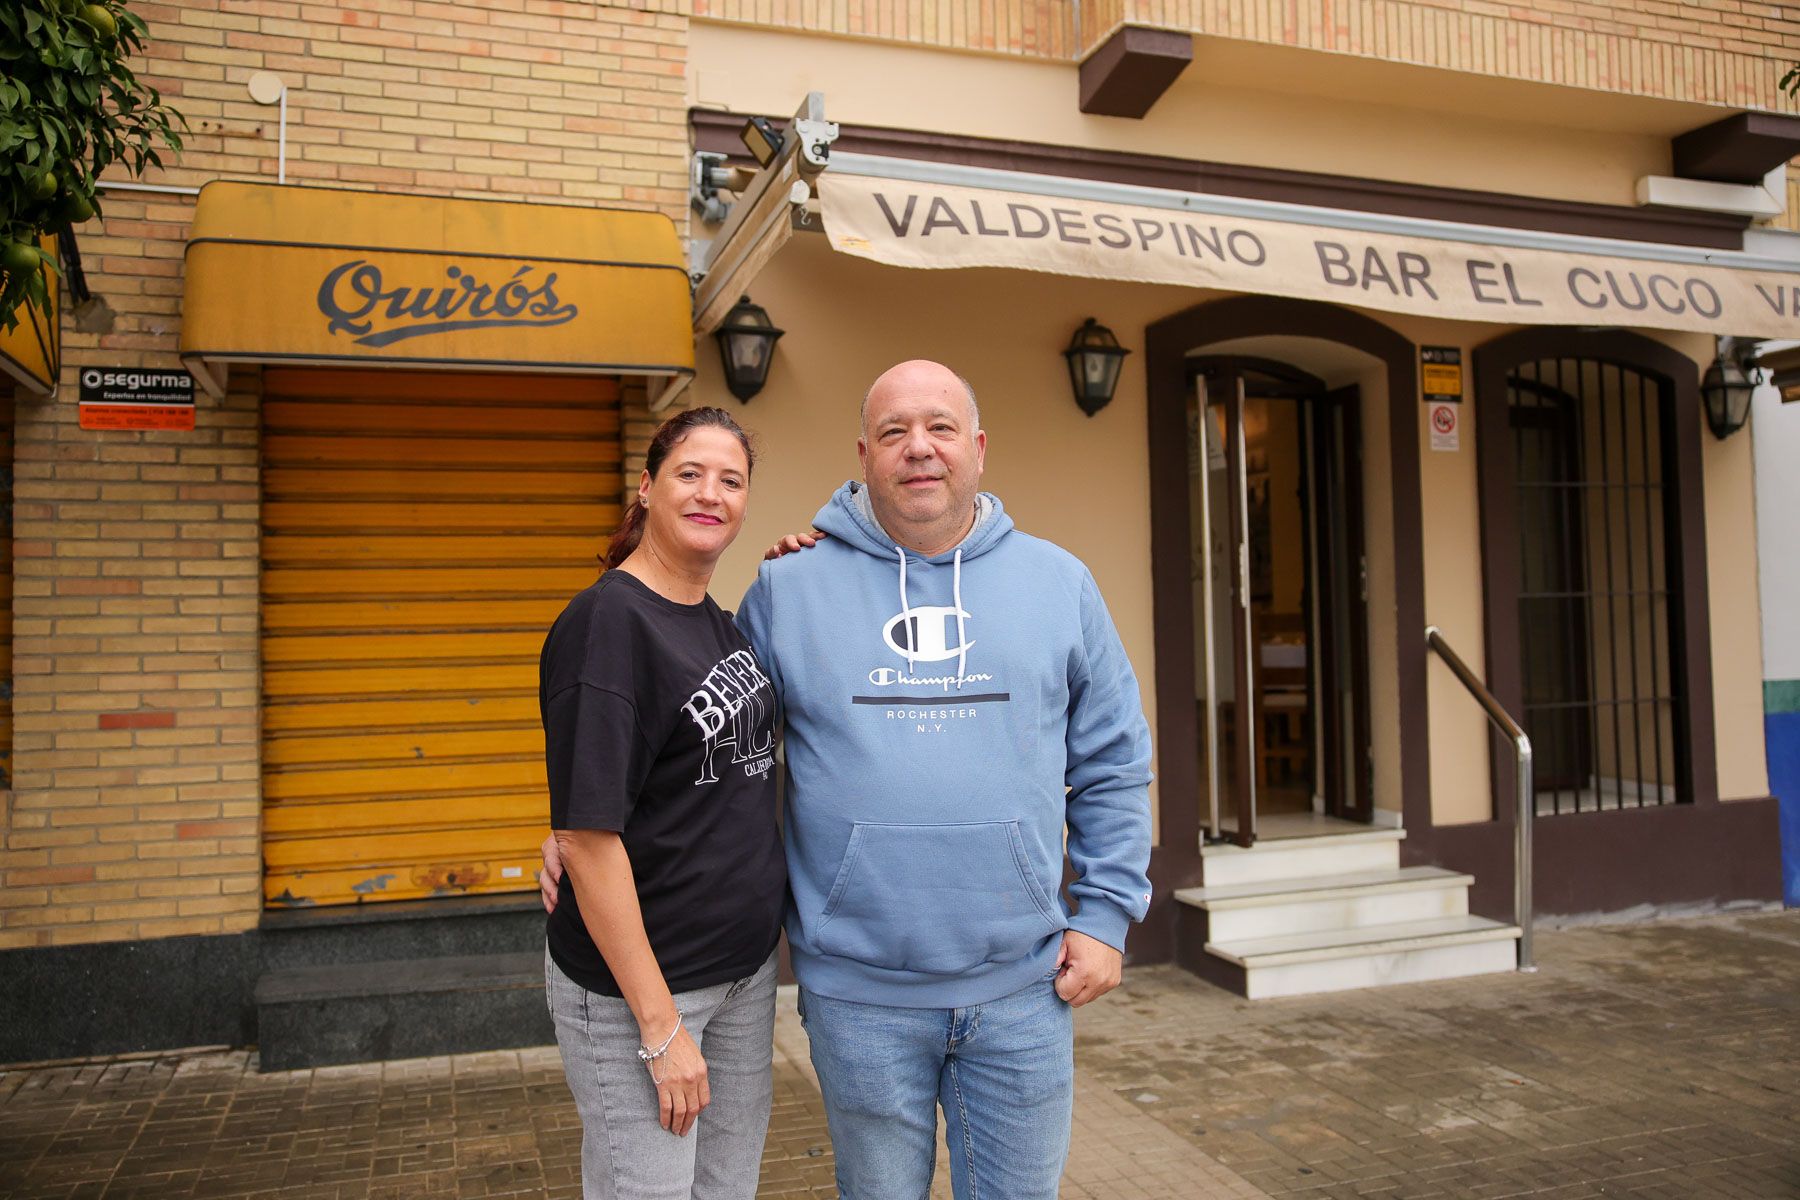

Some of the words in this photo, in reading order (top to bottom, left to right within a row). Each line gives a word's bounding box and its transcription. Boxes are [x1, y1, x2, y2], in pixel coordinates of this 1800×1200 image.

[873, 193, 1267, 267] VALDESPINO
[1314, 240, 1439, 301] BAR
[1466, 259, 1543, 307] EL
[1567, 267, 1723, 319] CUCO
[317, 260, 578, 347] Quirós
[104, 373, 191, 390] segurma
[887, 709, 977, 719] ROCHESTER
[917, 724, 947, 732] N.Y.
